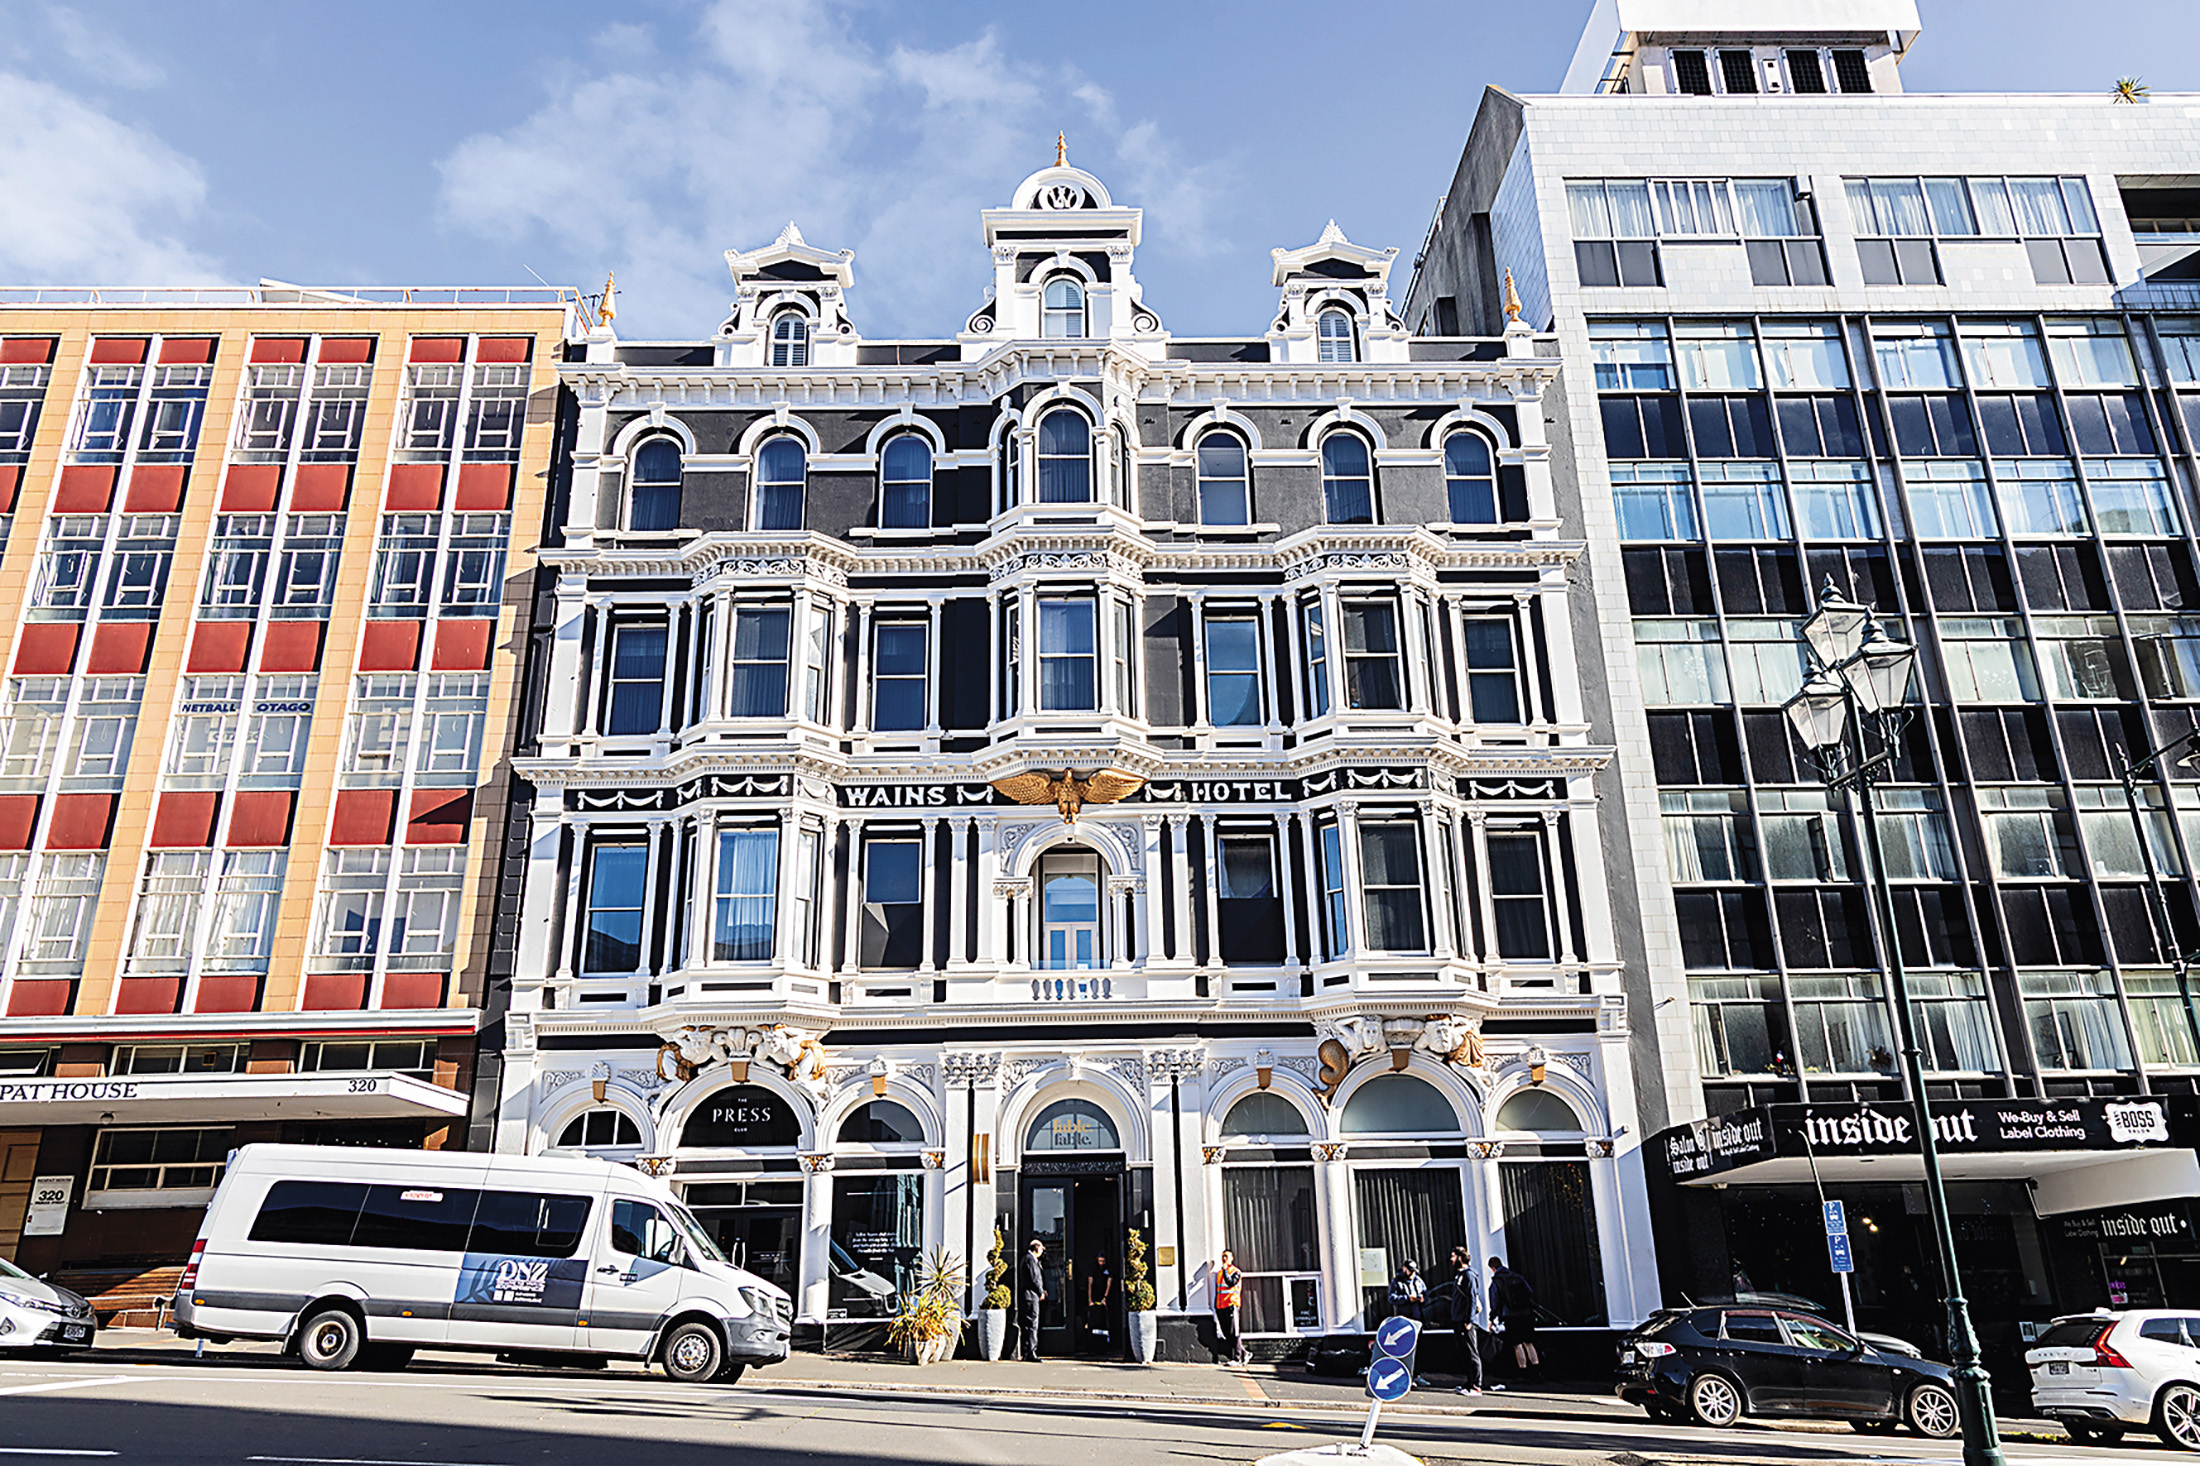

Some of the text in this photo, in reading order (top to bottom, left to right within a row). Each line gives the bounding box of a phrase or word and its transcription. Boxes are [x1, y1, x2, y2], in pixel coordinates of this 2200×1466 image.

[182, 702, 311, 712] NETBALL OTAGO
[845, 782, 1292, 806] WAINS HOTEL
[0, 1082, 138, 1100] PAT HOUSE
[348, 1079, 377, 1093] 320
[712, 1107, 771, 1122] PRESS
[2045, 1110, 2058, 1123] &
[2058, 1109, 2081, 1122] Sell
[2120, 1110, 2155, 1128] BOSS
[1712, 1117, 1763, 1150] inside out
[1804, 1108, 1912, 1145] inside
[2000, 1125, 2086, 1140] Label Clothing
[1672, 1153, 1709, 1174] inside out
[38, 1190, 64, 1201] 320
[2101, 1212, 2178, 1237] inside out
[499, 1260, 549, 1283] DNZ
